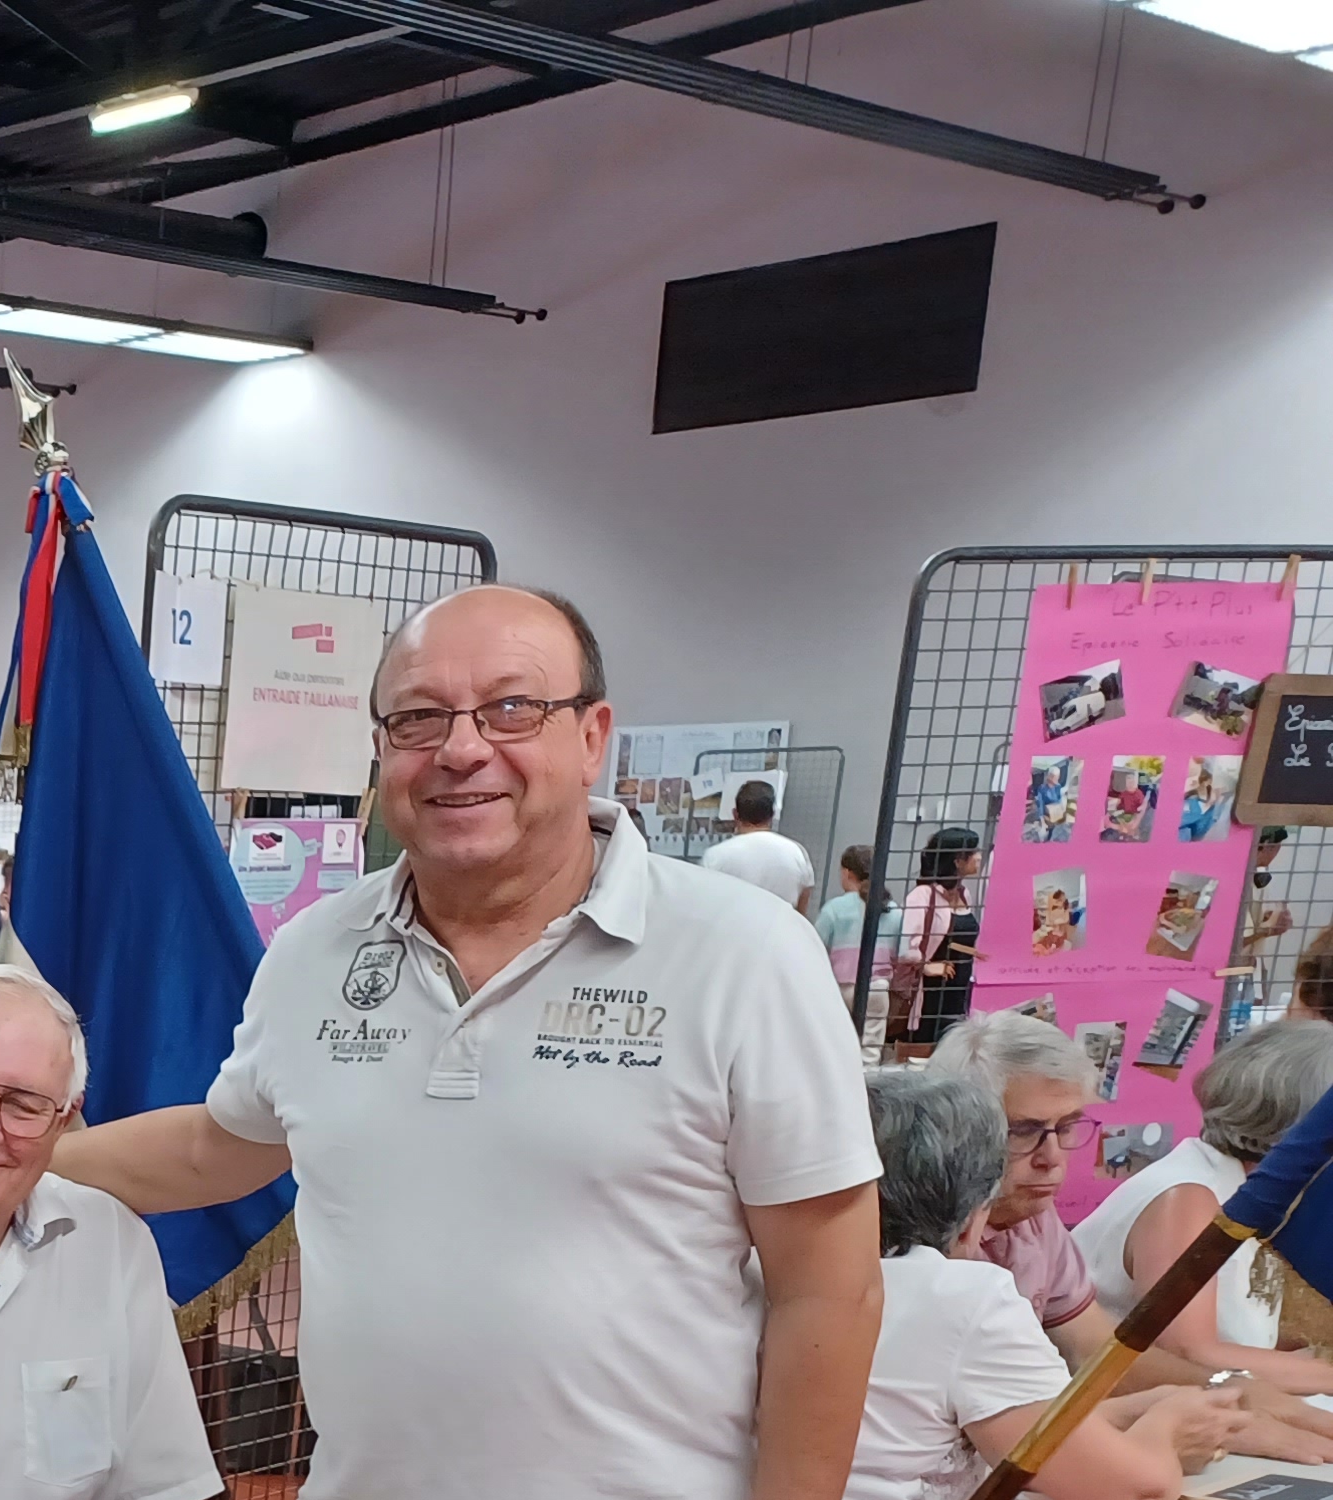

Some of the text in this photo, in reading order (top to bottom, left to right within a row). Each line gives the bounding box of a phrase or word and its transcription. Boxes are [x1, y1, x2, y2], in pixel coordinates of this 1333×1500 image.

[170, 608, 193, 647] 12
[252, 686, 302, 705] ENTRAIDE
[315, 1018, 413, 1045] Far Away
[536, 999, 668, 1039] DRC-02
